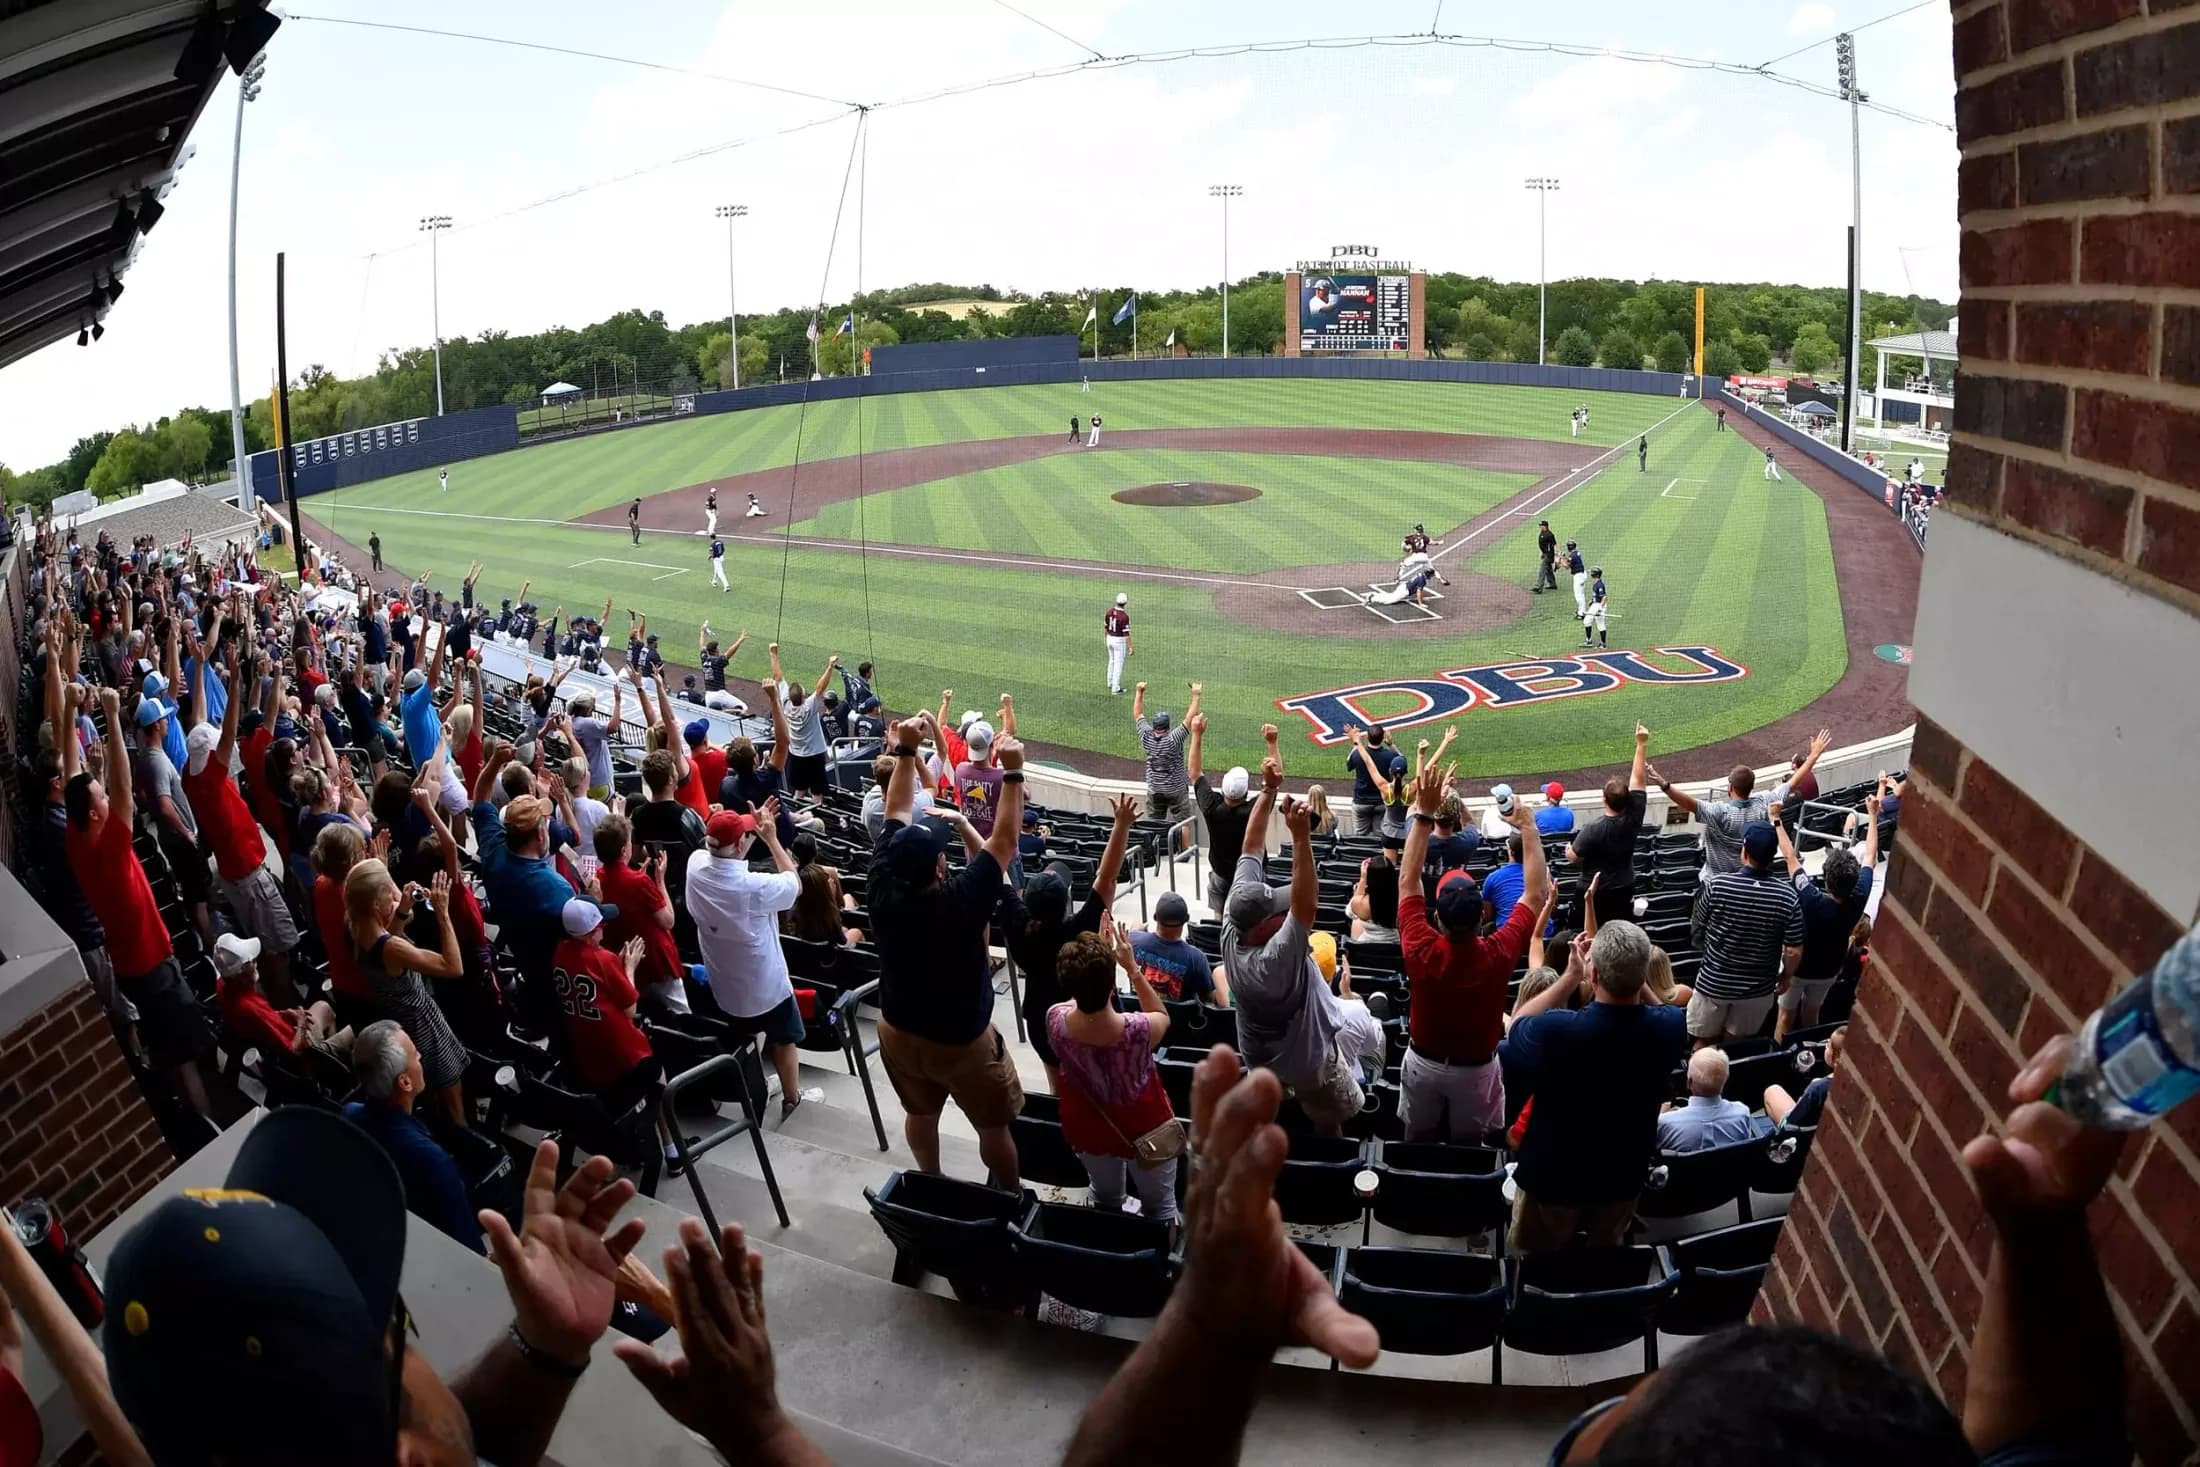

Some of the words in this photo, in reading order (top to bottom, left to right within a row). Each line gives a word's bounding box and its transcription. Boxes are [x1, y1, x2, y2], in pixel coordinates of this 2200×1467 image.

[1330, 244, 1379, 258] DBU
[1353, 260, 1411, 271] BASEBALL
[1275, 646, 1752, 747] DBU
[553, 966, 602, 1021] 22
